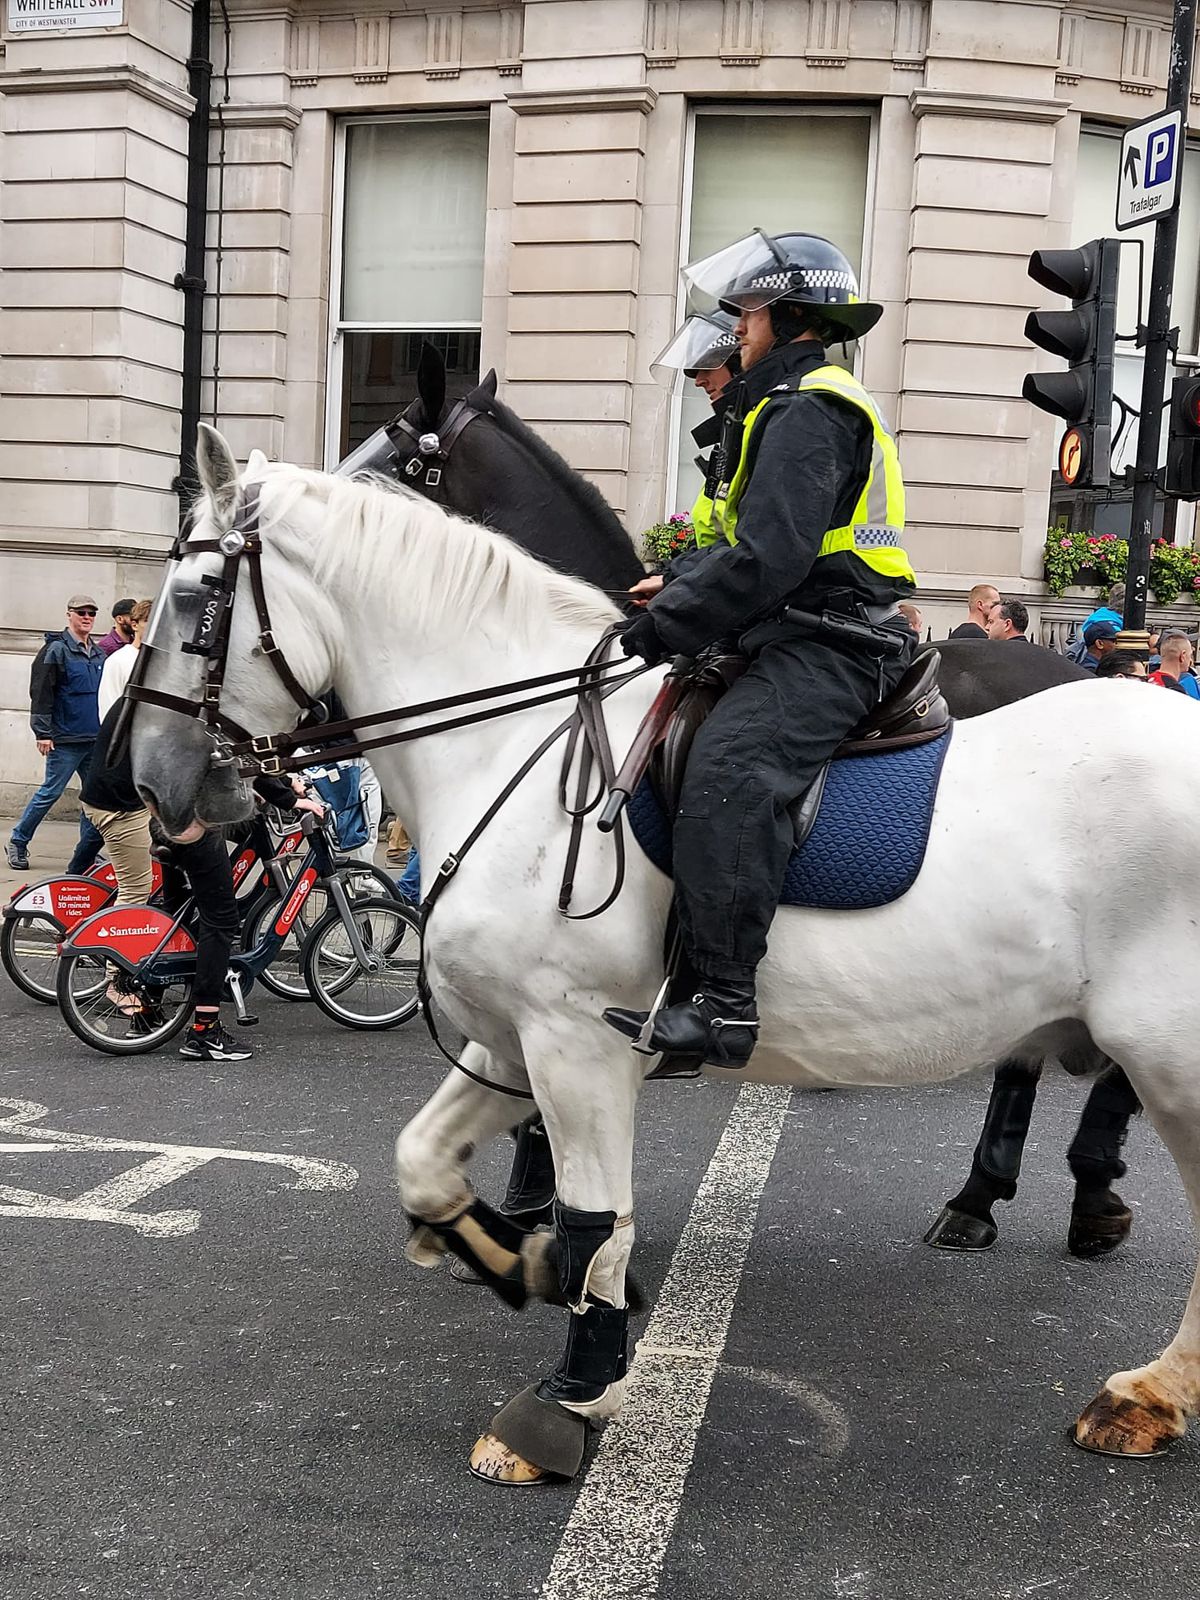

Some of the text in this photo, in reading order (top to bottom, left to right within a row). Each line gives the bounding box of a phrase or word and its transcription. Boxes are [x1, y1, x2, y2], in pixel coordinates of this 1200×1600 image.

[16, 0, 85, 11] WHITEHALL
[29, 19, 36, 27] OF
[38, 17, 77, 26] WESTMINSTER
[1149, 132, 1169, 182] P
[1129, 194, 1162, 214] Trafalgar
[32, 896, 44, 904] £3
[109, 924, 160, 937] Santander
